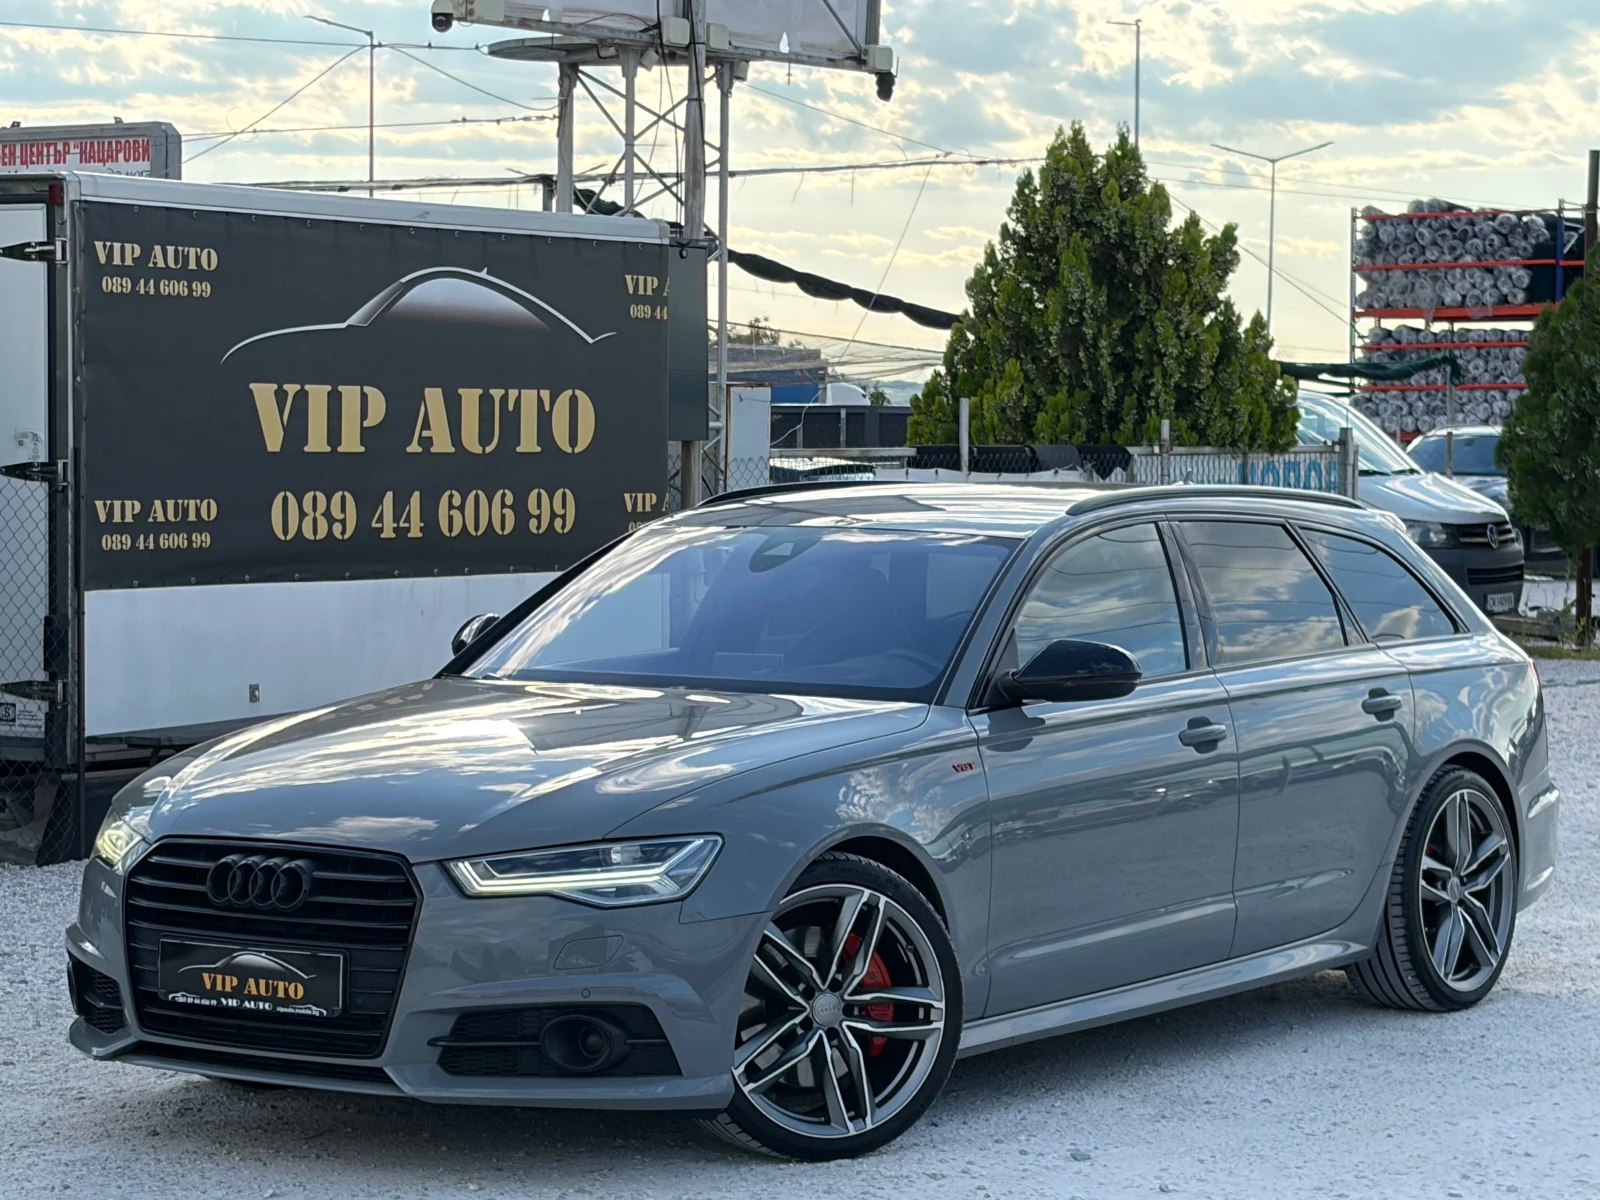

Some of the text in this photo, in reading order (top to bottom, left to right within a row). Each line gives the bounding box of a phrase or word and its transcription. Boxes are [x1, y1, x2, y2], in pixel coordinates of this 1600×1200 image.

[19, 141, 71, 169] ЦЕНТЪР
[94, 240, 218, 271] VIP AUTO
[102, 276, 211, 298] 089 44 606 99
[624, 274, 659, 296] VIP
[630, 304, 652, 319] 089
[249, 383, 596, 454] VIP AUTO
[94, 499, 218, 523] VIP AUTO
[623, 492, 657, 512] VIP
[271, 487, 576, 541] 089 44 606 99
[101, 532, 211, 551] 089 44 606 99
[201, 972, 305, 1000] VIP AUTO
[220, 997, 241, 1007] VIP
[242, 1000, 273, 1010] AUTO
